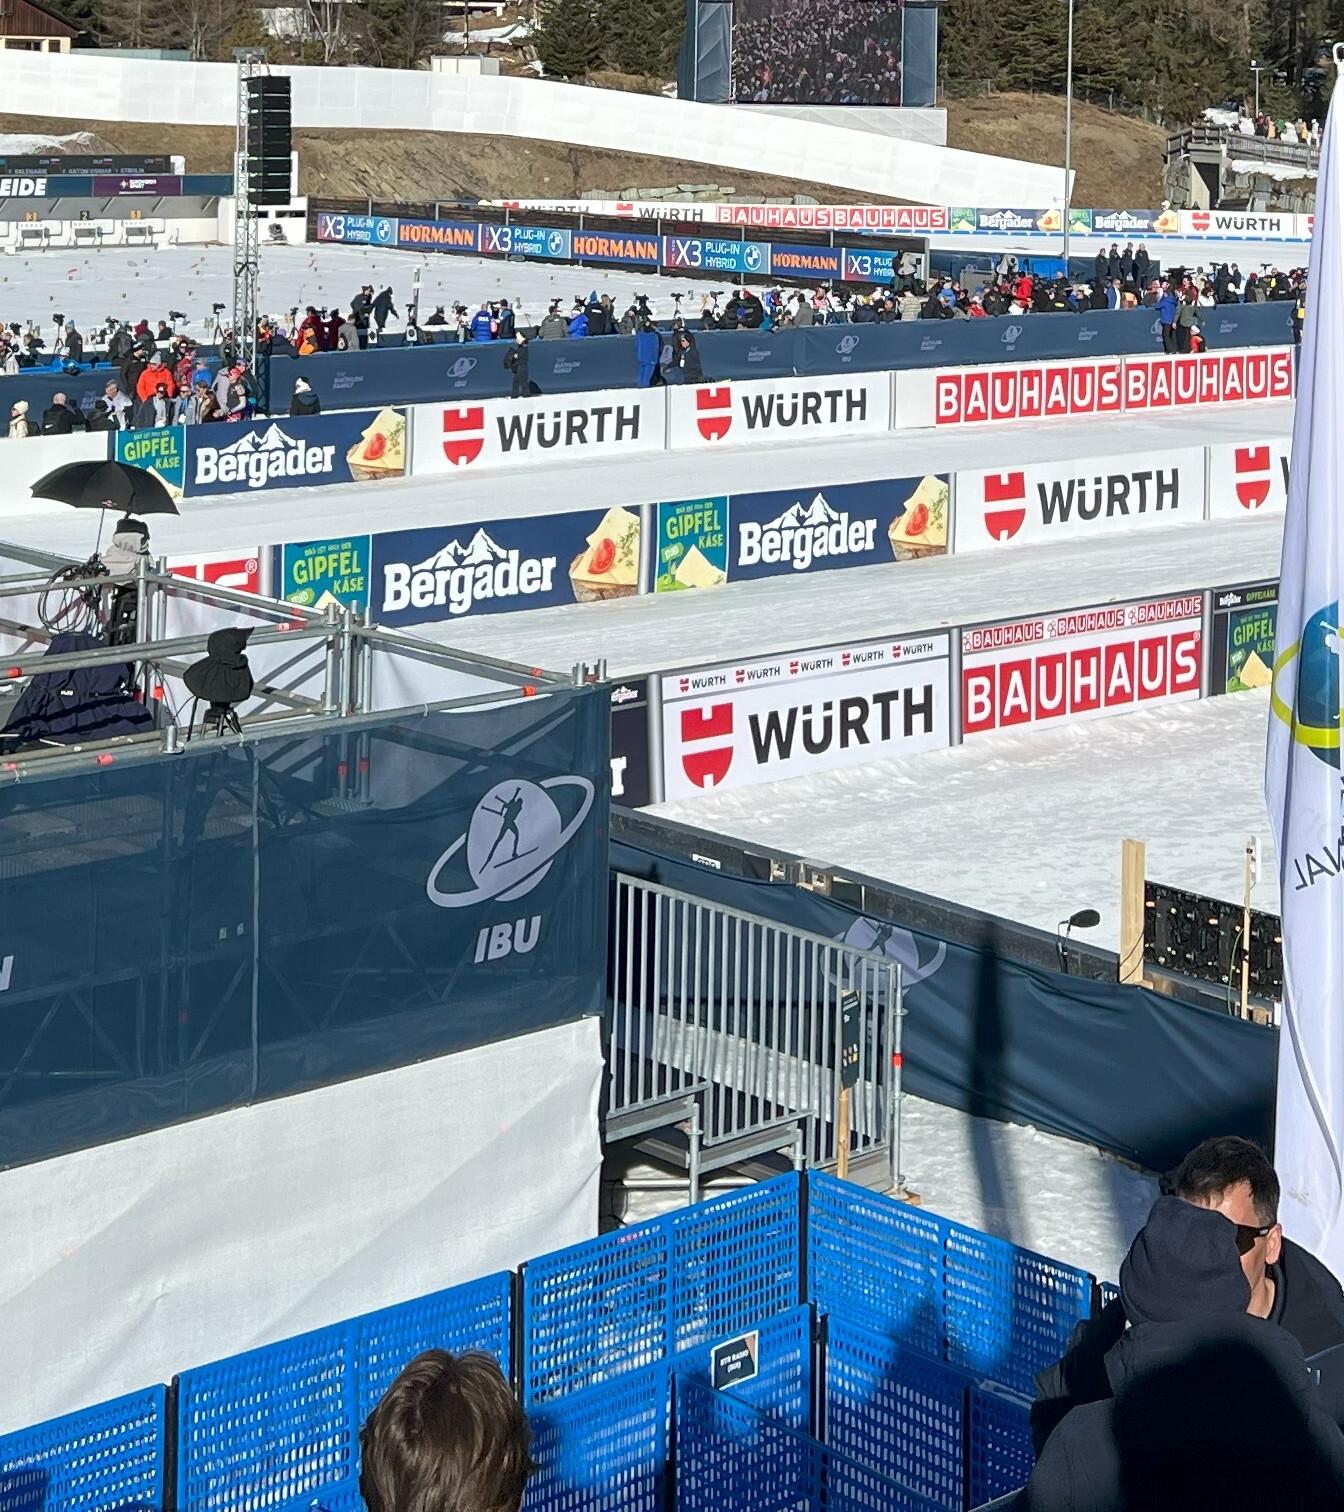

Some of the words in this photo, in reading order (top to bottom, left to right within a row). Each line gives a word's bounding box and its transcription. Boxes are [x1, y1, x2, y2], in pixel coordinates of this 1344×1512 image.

[639, 207, 704, 221] WÜRTH
[720, 207, 831, 225] BAUHAUS
[835, 208, 945, 228] BAUHAUS
[979, 213, 1033, 230] Bergader
[1095, 215, 1149, 232] Bergader
[1215, 216, 1281, 232] WÜRTH
[324, 215, 345, 239] X3
[347, 217, 374, 229] PLUG-IN
[347, 229, 371, 241] HYBRID
[488, 226, 512, 252] X3
[514, 228, 546, 241] PLUG-IN
[514, 241, 543, 254] HYBRID
[676, 240, 701, 266] X3
[705, 242, 741, 255] PLUG-IN
[705, 256, 736, 269] HYBRID
[851, 256, 872, 275] X3
[1128, 358, 1289, 402] BAUHAUS
[939, 368, 1119, 419] BAUHAUS
[742, 388, 867, 430] WÜRTH
[496, 405, 641, 453] WÜRTH
[124, 436, 178, 461] GIPFEL
[156, 455, 180, 469] KÄSE
[195, 439, 336, 488] Bergader
[1037, 468, 1179, 524] WÜRTH
[666, 510, 721, 539] GIPFEL
[698, 532, 723, 551] KÄSE
[739, 512, 877, 570] Bergader
[293, 551, 361, 585] GIPFEL
[333, 576, 365, 595] KÄSE
[383, 549, 556, 614] Bergader
[1058, 609, 1125, 635] BAUHAUS
[1138, 595, 1202, 624] BAUHAUS
[973, 622, 1044, 649] BAUHAUS
[1233, 620, 1275, 647] GIPFEL
[852, 650, 884, 664] WÜRTH
[902, 642, 934, 656] WÜRTH
[747, 666, 781, 681] WÜRTH
[800, 658, 834, 672] WÜRTH
[691, 675, 726, 690] WÜRTH
[967, 641, 1197, 724] BAUHAUS
[748, 684, 934, 765] WÜRTH
[474, 915, 542, 964] IBU
